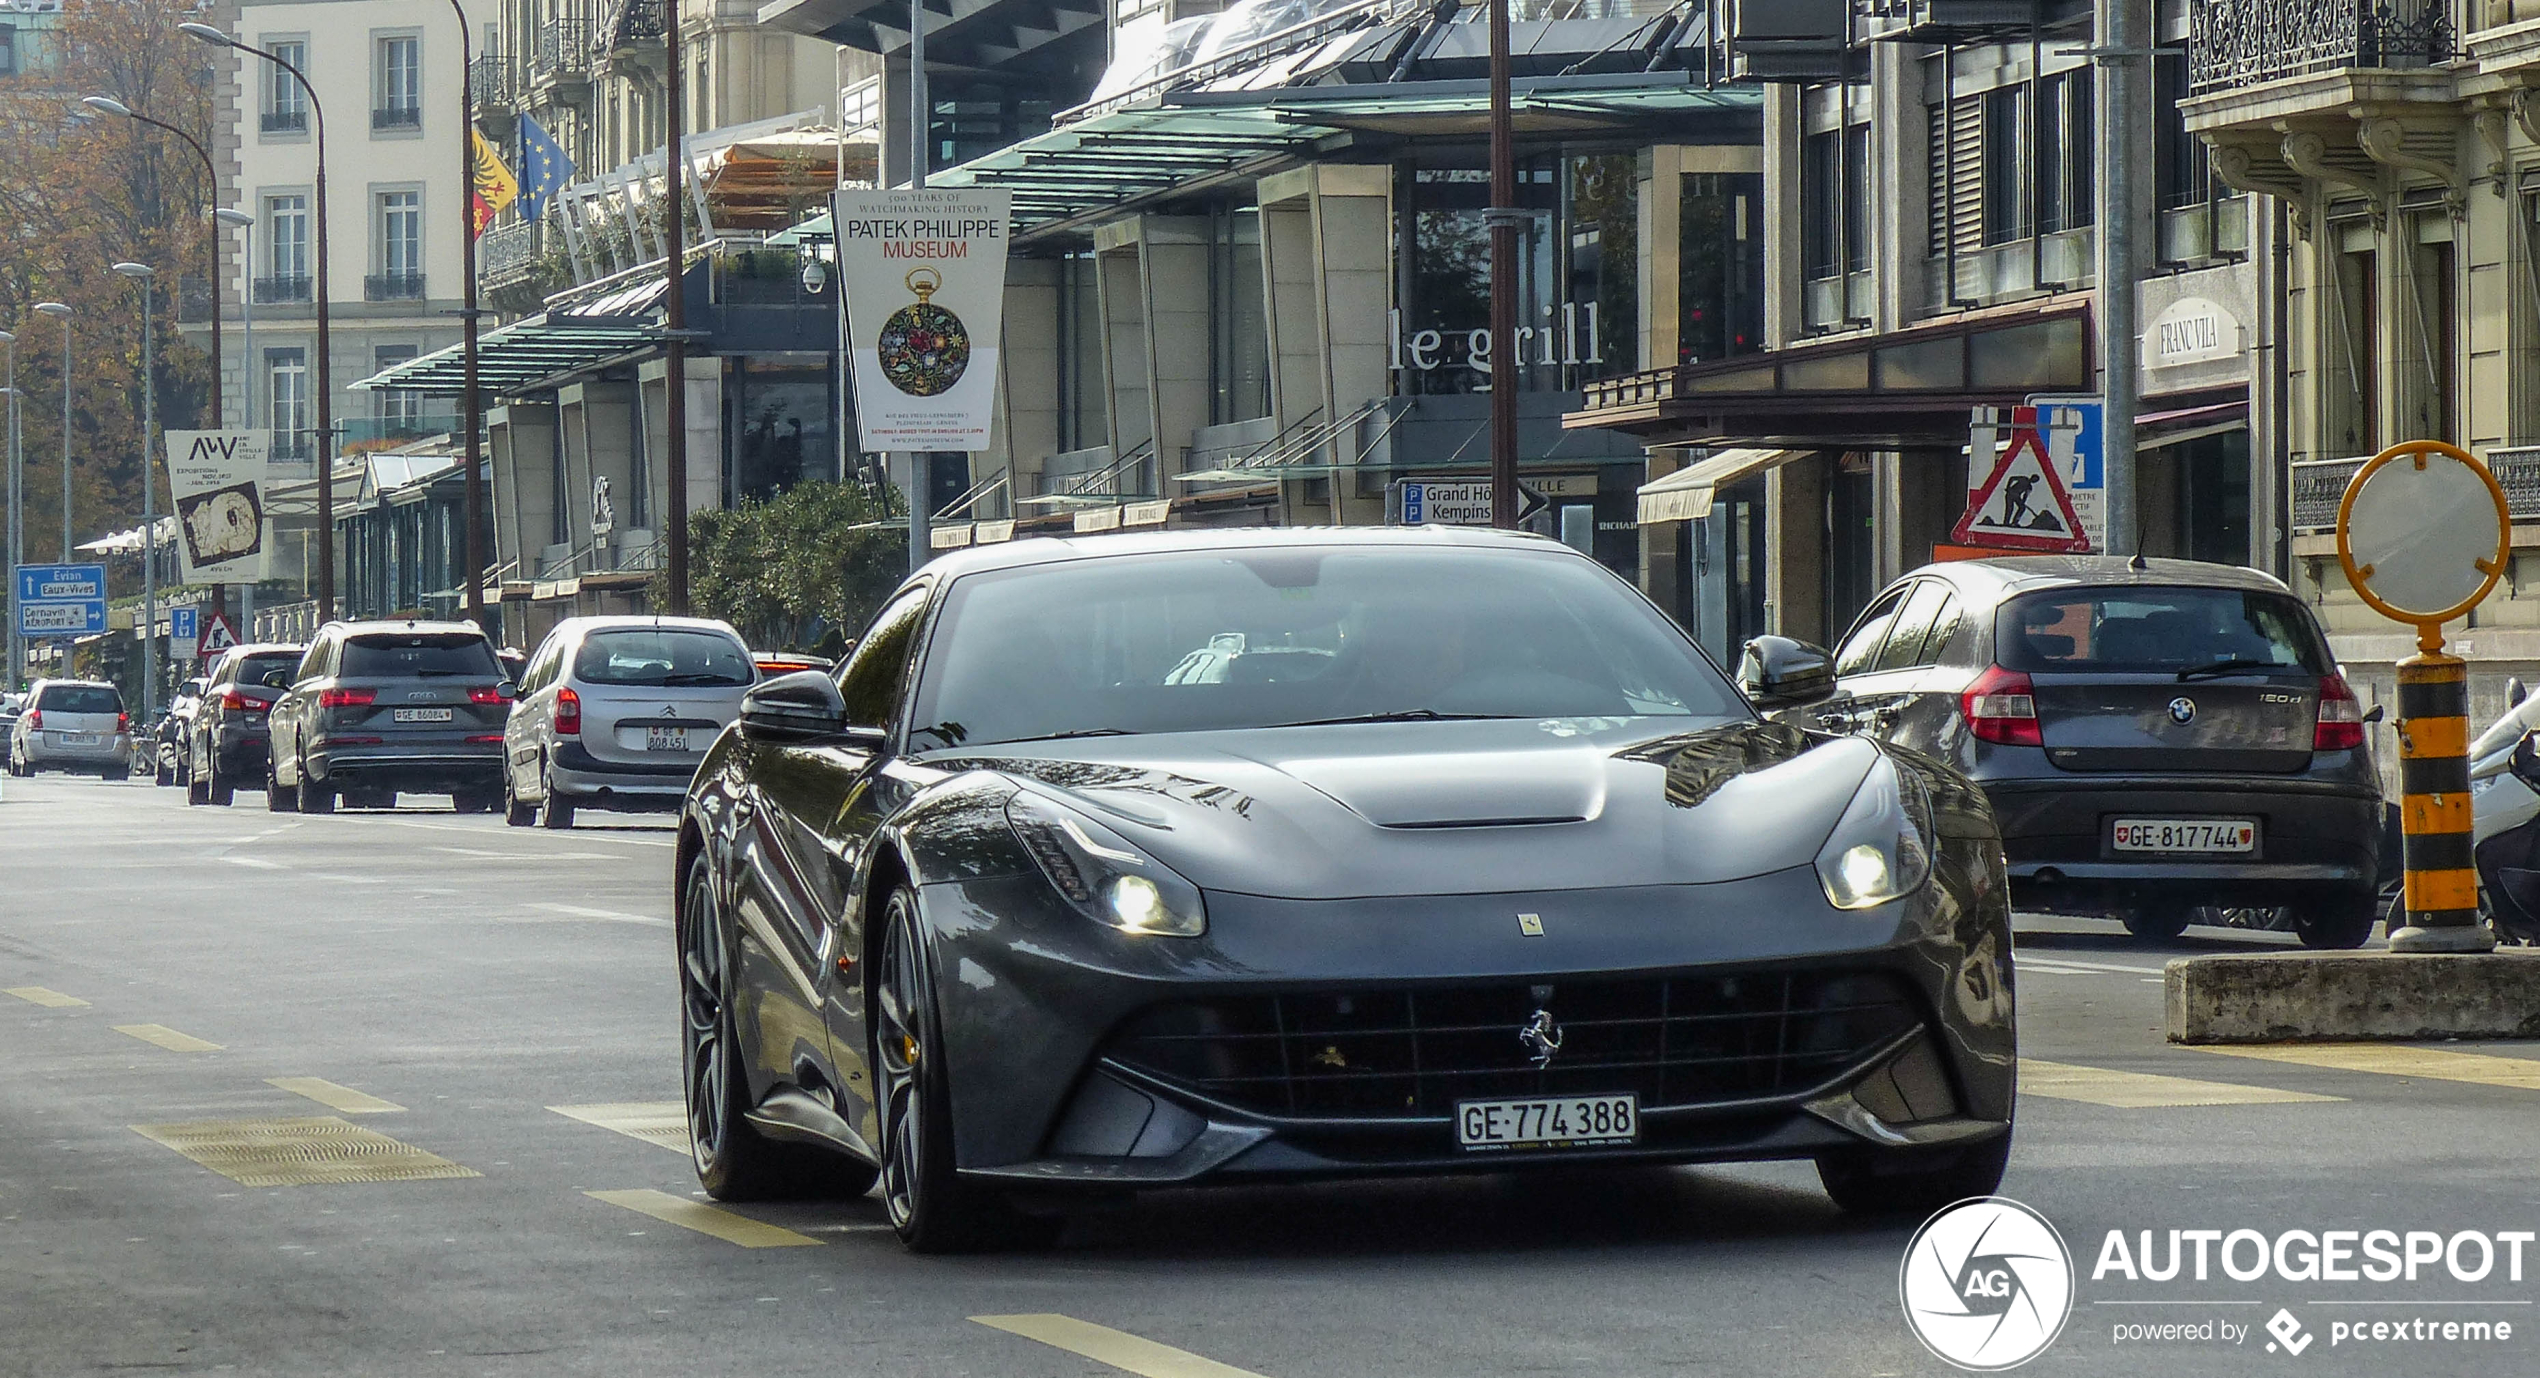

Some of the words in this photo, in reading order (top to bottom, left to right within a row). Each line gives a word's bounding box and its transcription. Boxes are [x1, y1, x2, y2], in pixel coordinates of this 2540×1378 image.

[911, 193, 943, 202] YEARS
[946, 193, 961, 202] OF
[859, 204, 940, 213] WATCHMAKING
[944, 204, 989, 213] HISTORY
[848, 219, 908, 238] PATEK
[914, 219, 999, 238] PHILIPPE
[883, 241, 967, 259] MUSEUM
[1388, 308, 1442, 370] le
[2160, 319, 2193, 355] FRANC
[2194, 316, 2217, 349] VILA
[1426, 485, 1469, 501] Grand
[1473, 485, 1492, 501] Hô
[1528, 480, 1566, 492] ILLE
[1432, 503, 1491, 522] Kempins
[53, 570, 82, 581] Evian
[42, 584, 94, 595] Eaux-Vives
[25, 607, 66, 618] Cornavin
